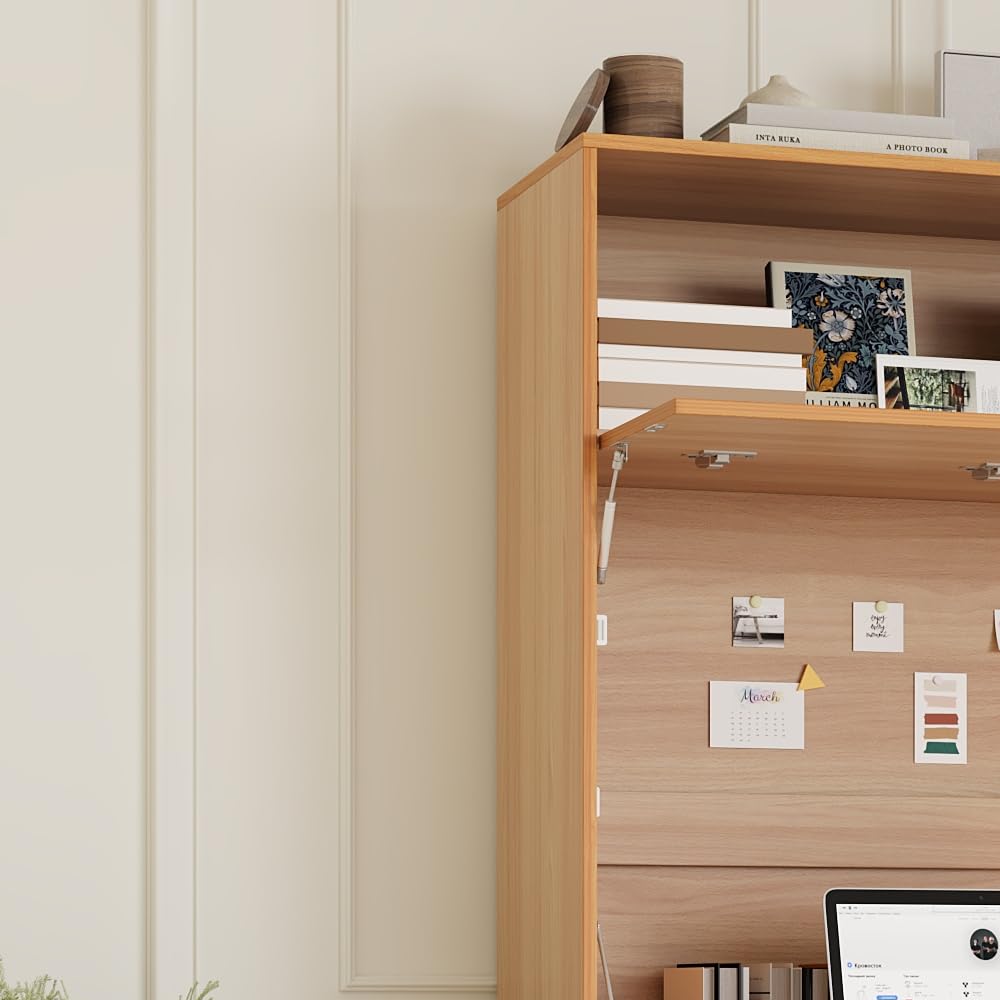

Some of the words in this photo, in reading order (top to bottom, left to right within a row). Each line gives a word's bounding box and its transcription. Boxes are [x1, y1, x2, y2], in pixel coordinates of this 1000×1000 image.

[756, 133, 776, 142] INTA
[778, 135, 801, 144] RUKA
[886, 143, 892, 151] A
[894, 144, 923, 153] PHOTO
[925, 146, 948, 154] BOOK
[740, 688, 781, 704] March
